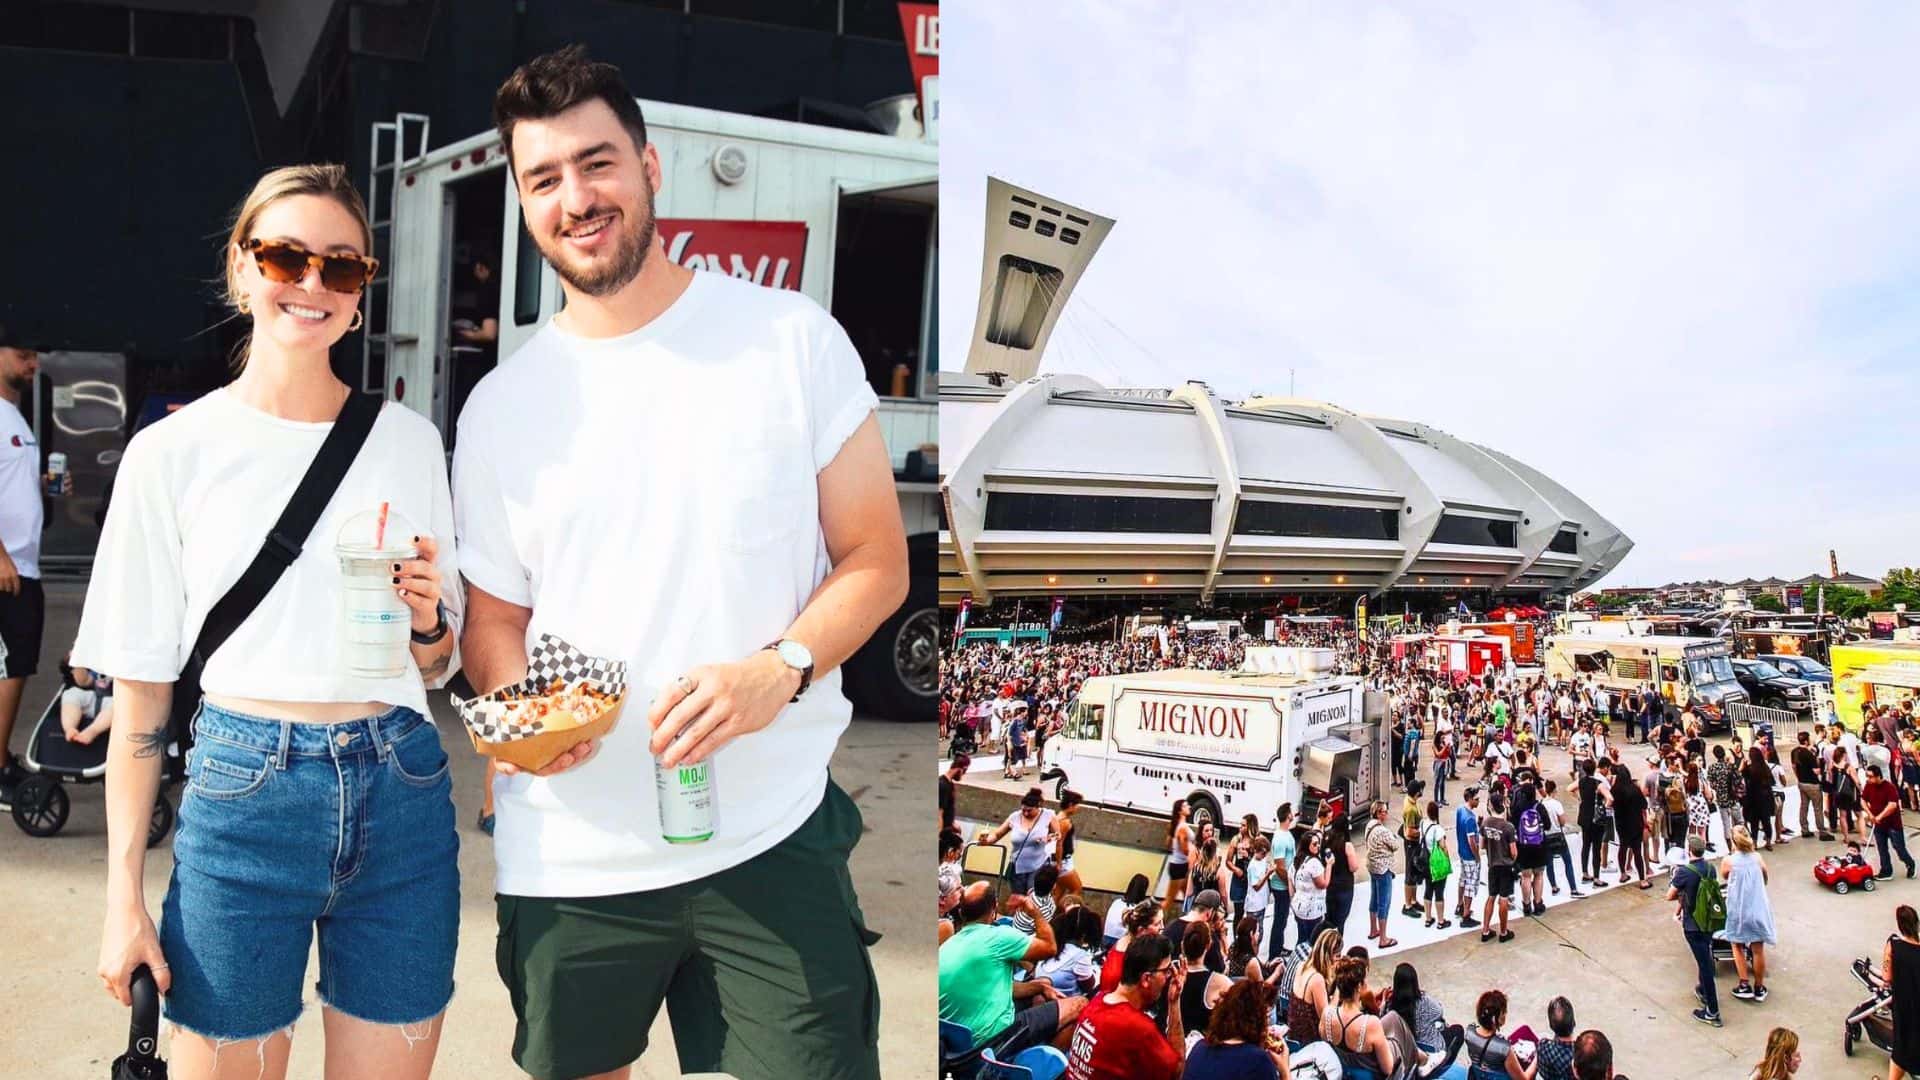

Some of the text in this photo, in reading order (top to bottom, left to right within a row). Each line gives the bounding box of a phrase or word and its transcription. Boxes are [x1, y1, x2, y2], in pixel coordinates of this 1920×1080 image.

[1138, 701, 1248, 739] MIGNON
[1307, 704, 1346, 727] MIGNON
[1133, 765, 1247, 792] Churros & Nougat
